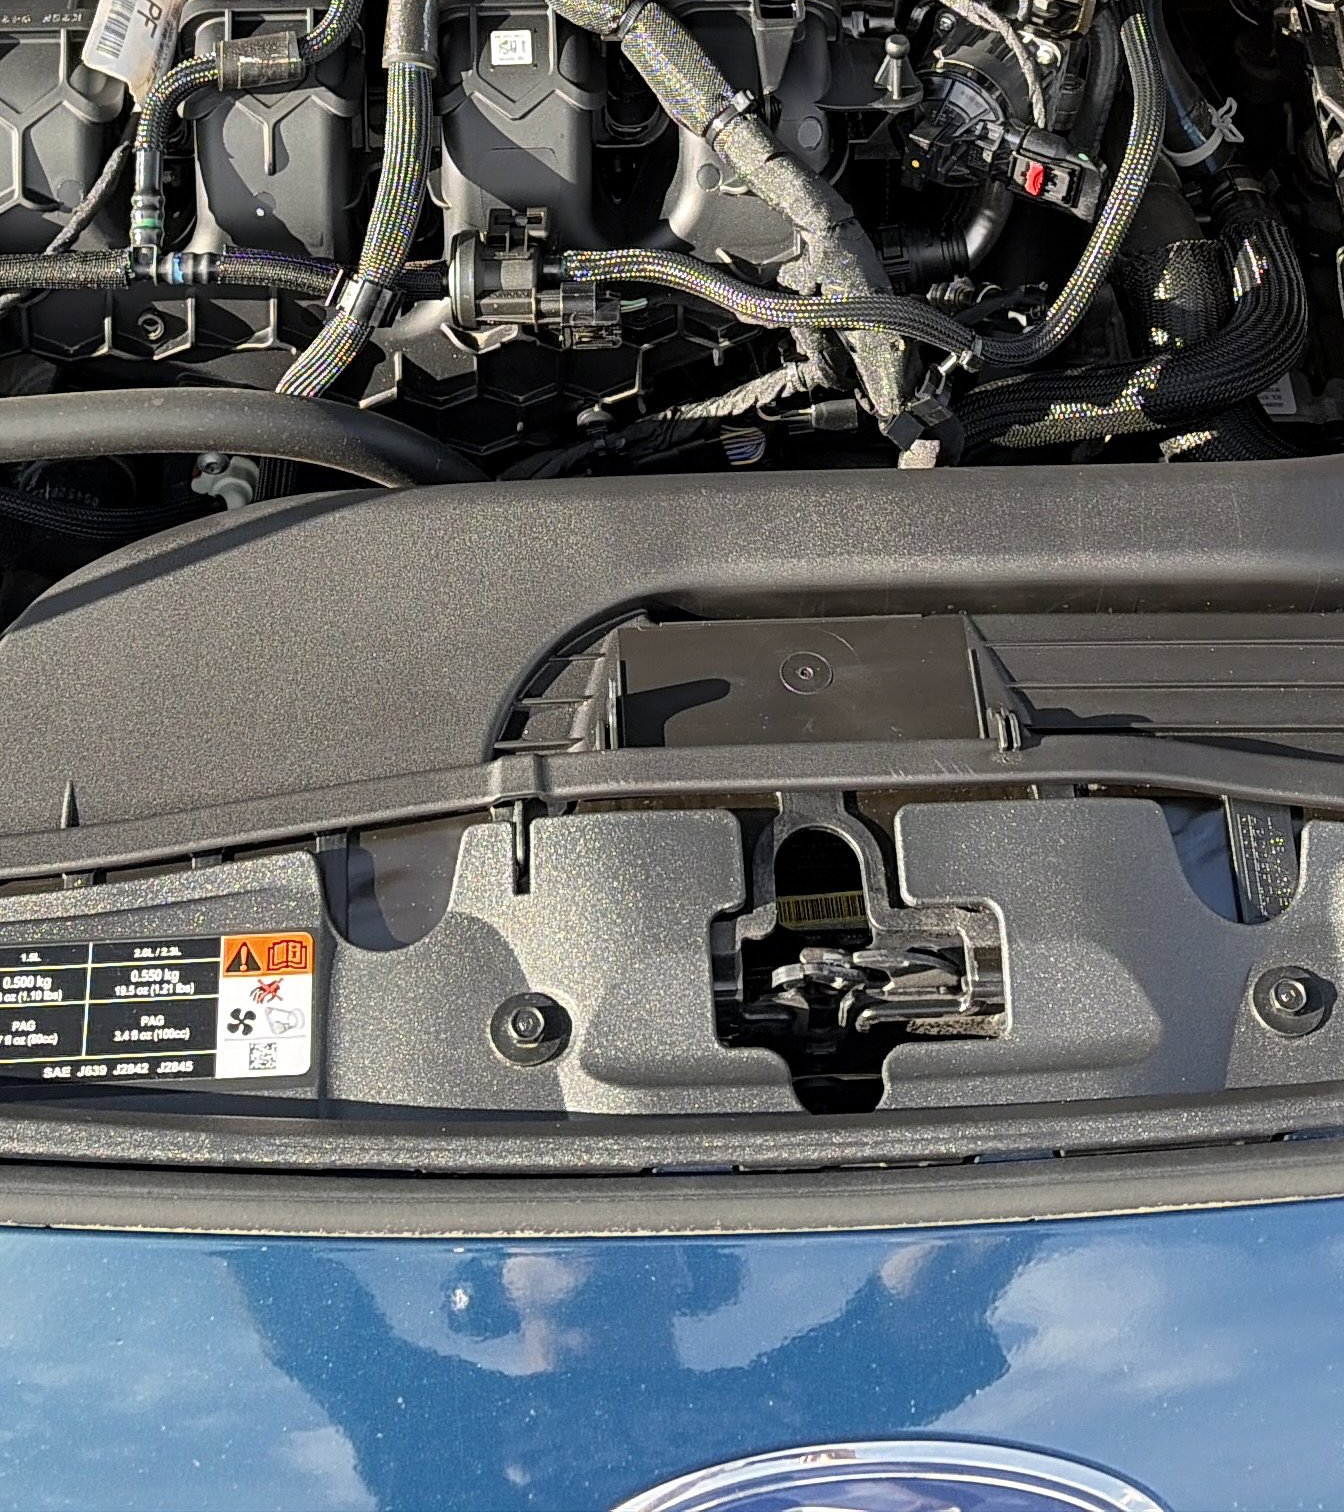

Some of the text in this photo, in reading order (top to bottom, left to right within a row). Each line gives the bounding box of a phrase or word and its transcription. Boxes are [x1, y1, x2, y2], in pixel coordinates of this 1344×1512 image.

[131, 968, 180, 983] 0.550 kg
[2, 976, 52, 990] 0.500 kg
[136, 987, 149, 995] oz
[4, 994, 17, 1002] oz
[11, 1020, 36, 1032] PAG
[141, 1015, 165, 1027] PAG
[13, 1036, 26, 1046] oz
[140, 1031, 152, 1040] oz
[43, 1066, 71, 1079] SAE
[77, 1065, 108, 1078] J639
[113, 1063, 149, 1076] J2842
